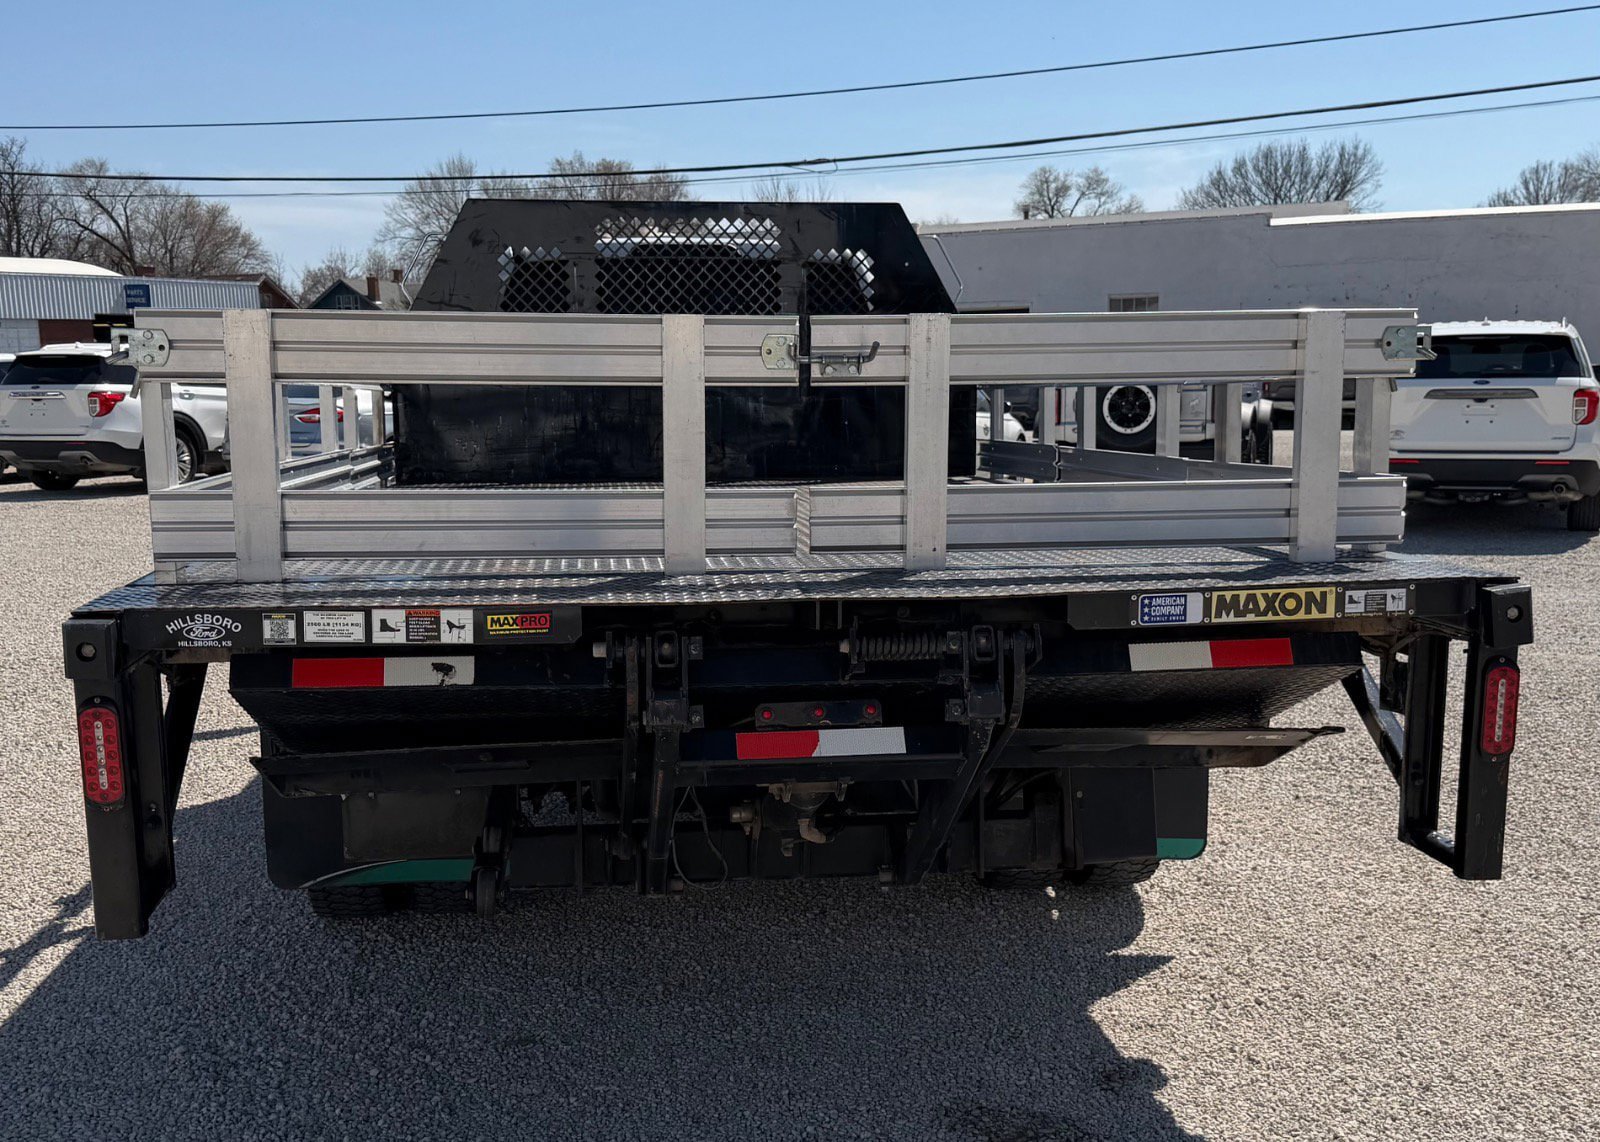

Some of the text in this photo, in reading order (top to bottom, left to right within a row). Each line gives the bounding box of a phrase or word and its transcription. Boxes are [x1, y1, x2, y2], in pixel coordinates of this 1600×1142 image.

[1151, 596, 1185, 606] AMERICAN
[1213, 591, 1328, 619] MAXON
[1151, 605, 1184, 615] COMPANY
[165, 613, 242, 634] HILLSBORO
[489, 615, 548, 628] MAXPRO
[190, 626, 218, 638] Ford
[177, 640, 221, 648] HILLSBORO,
